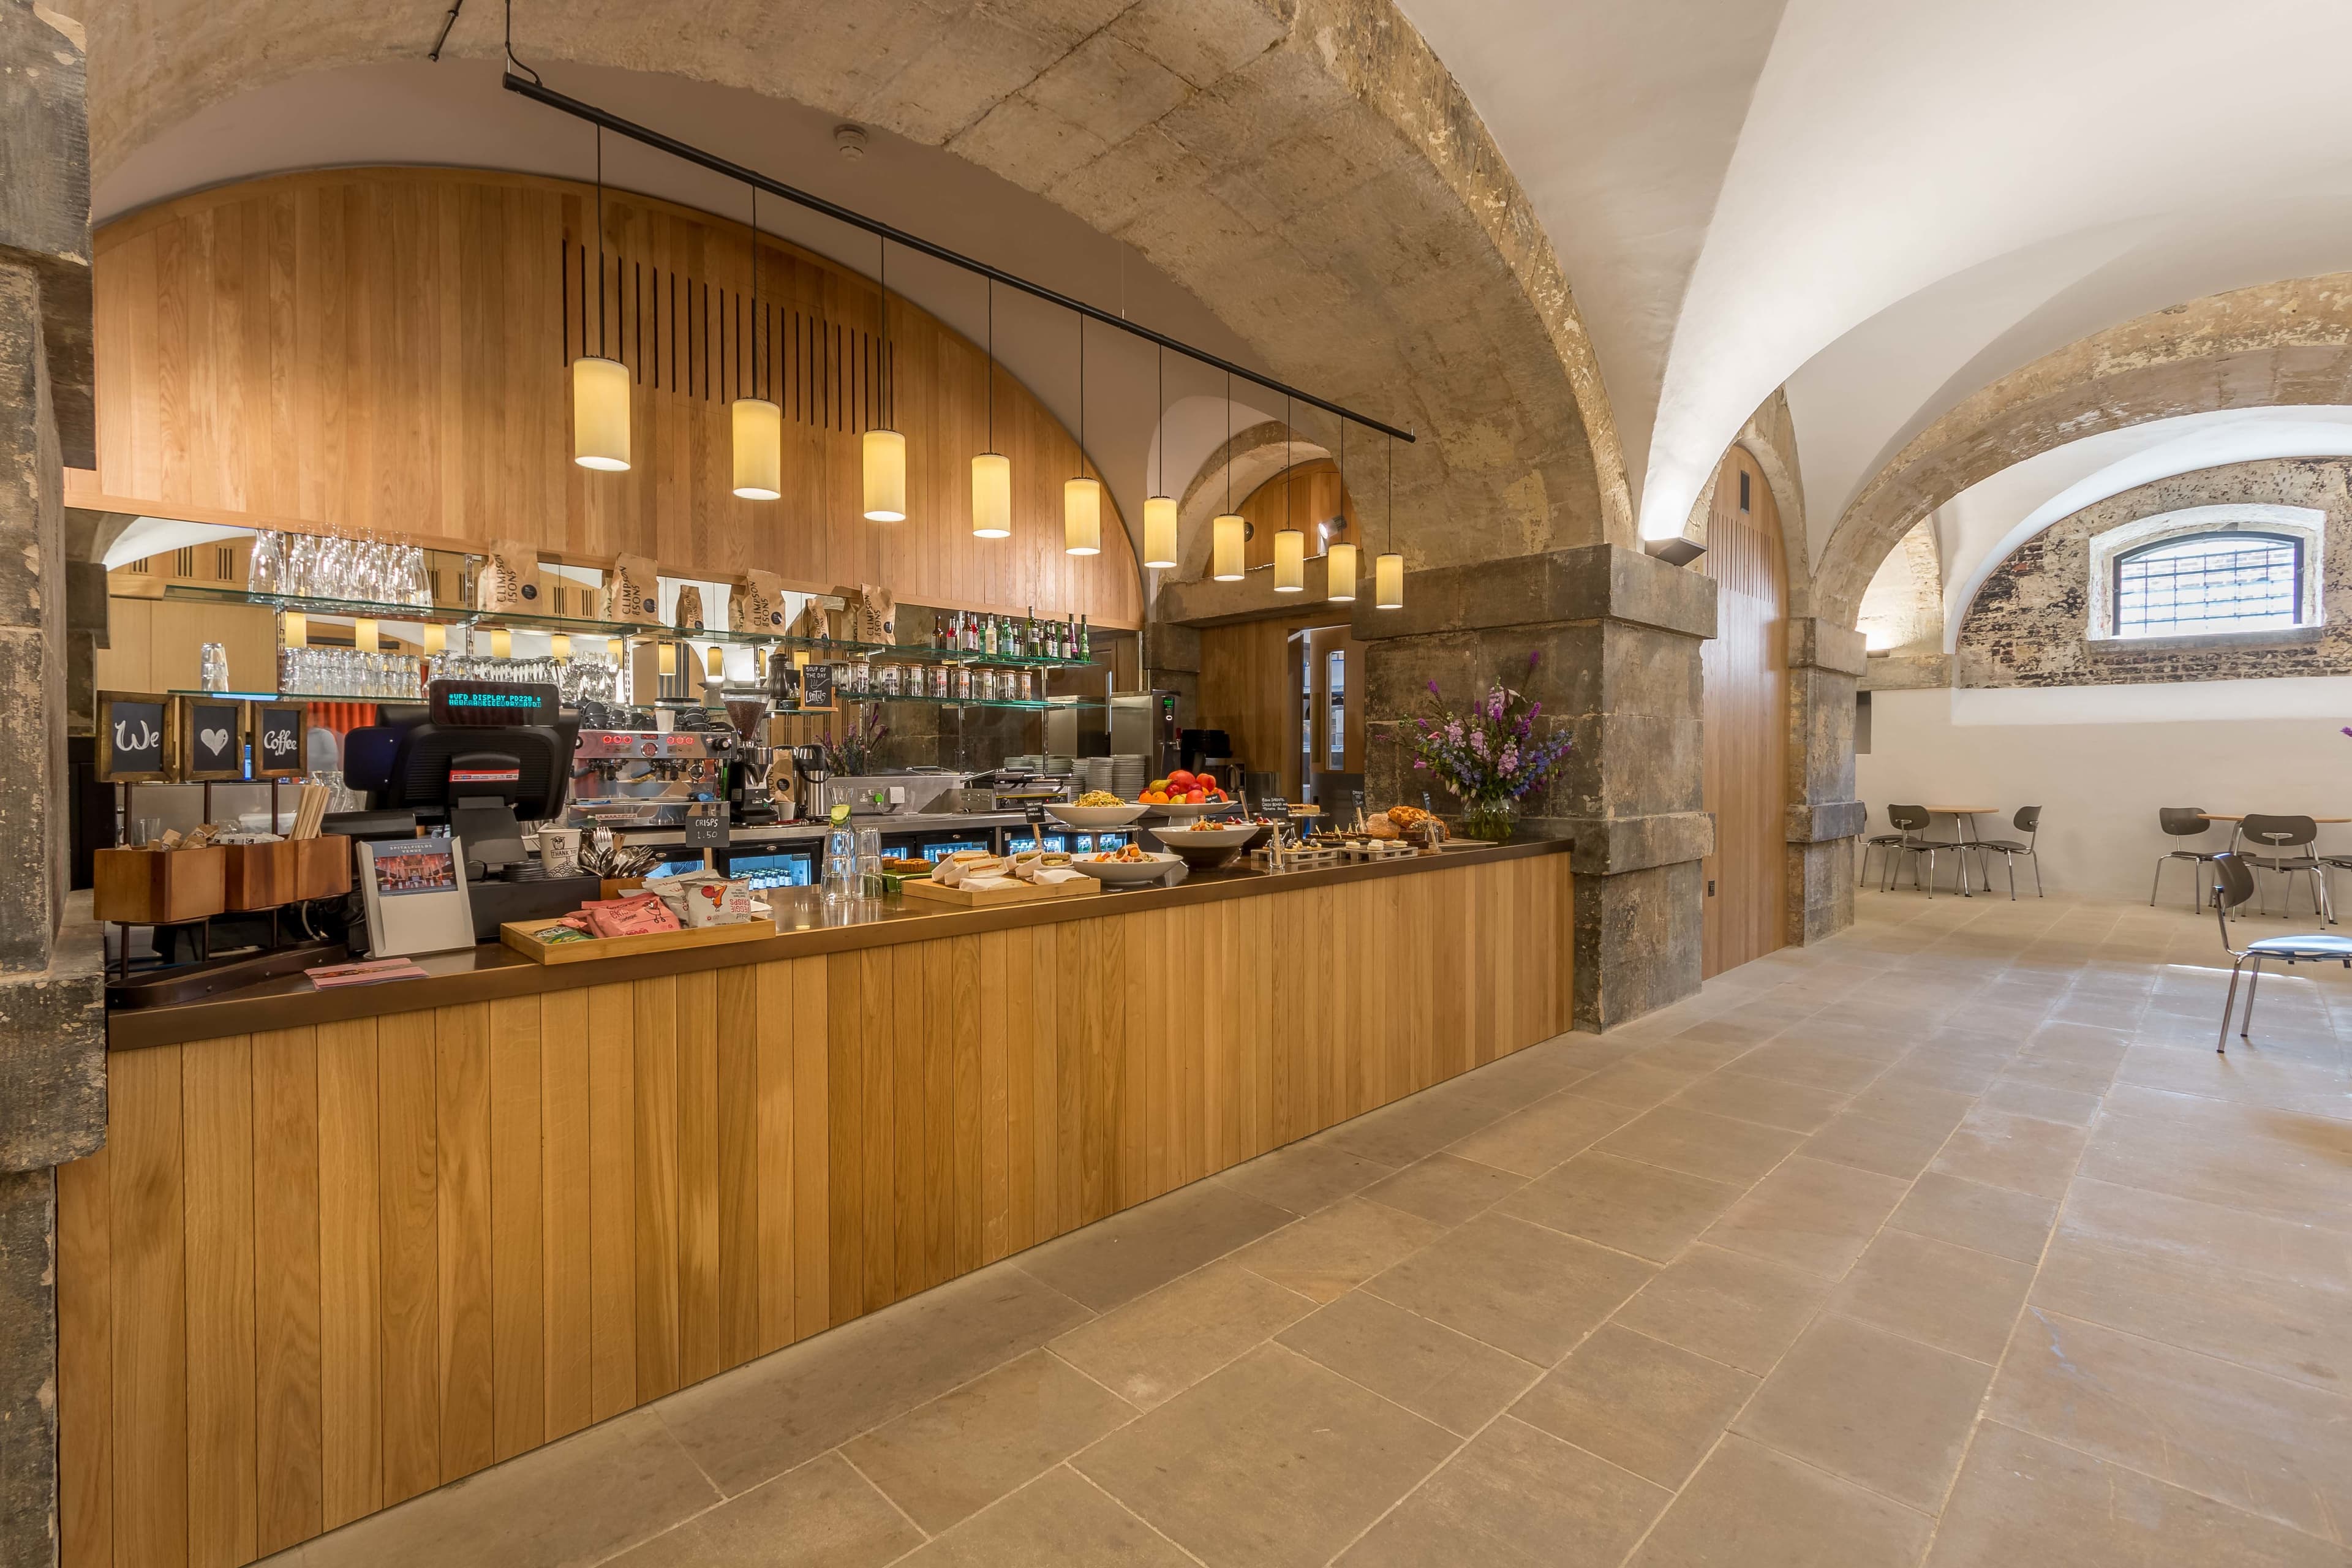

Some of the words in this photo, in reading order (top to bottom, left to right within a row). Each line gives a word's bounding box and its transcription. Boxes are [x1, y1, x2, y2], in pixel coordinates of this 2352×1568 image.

[619, 566, 631, 614] CLIMPSON
[750, 581, 761, 626] CLIMPSON
[865, 595, 874, 636] CLIMPSON
[115, 720, 159, 751] We
[264, 729, 298, 756] Coffee
[695, 818, 718, 827] CRISPS
[698, 831, 718, 839] 1.50
